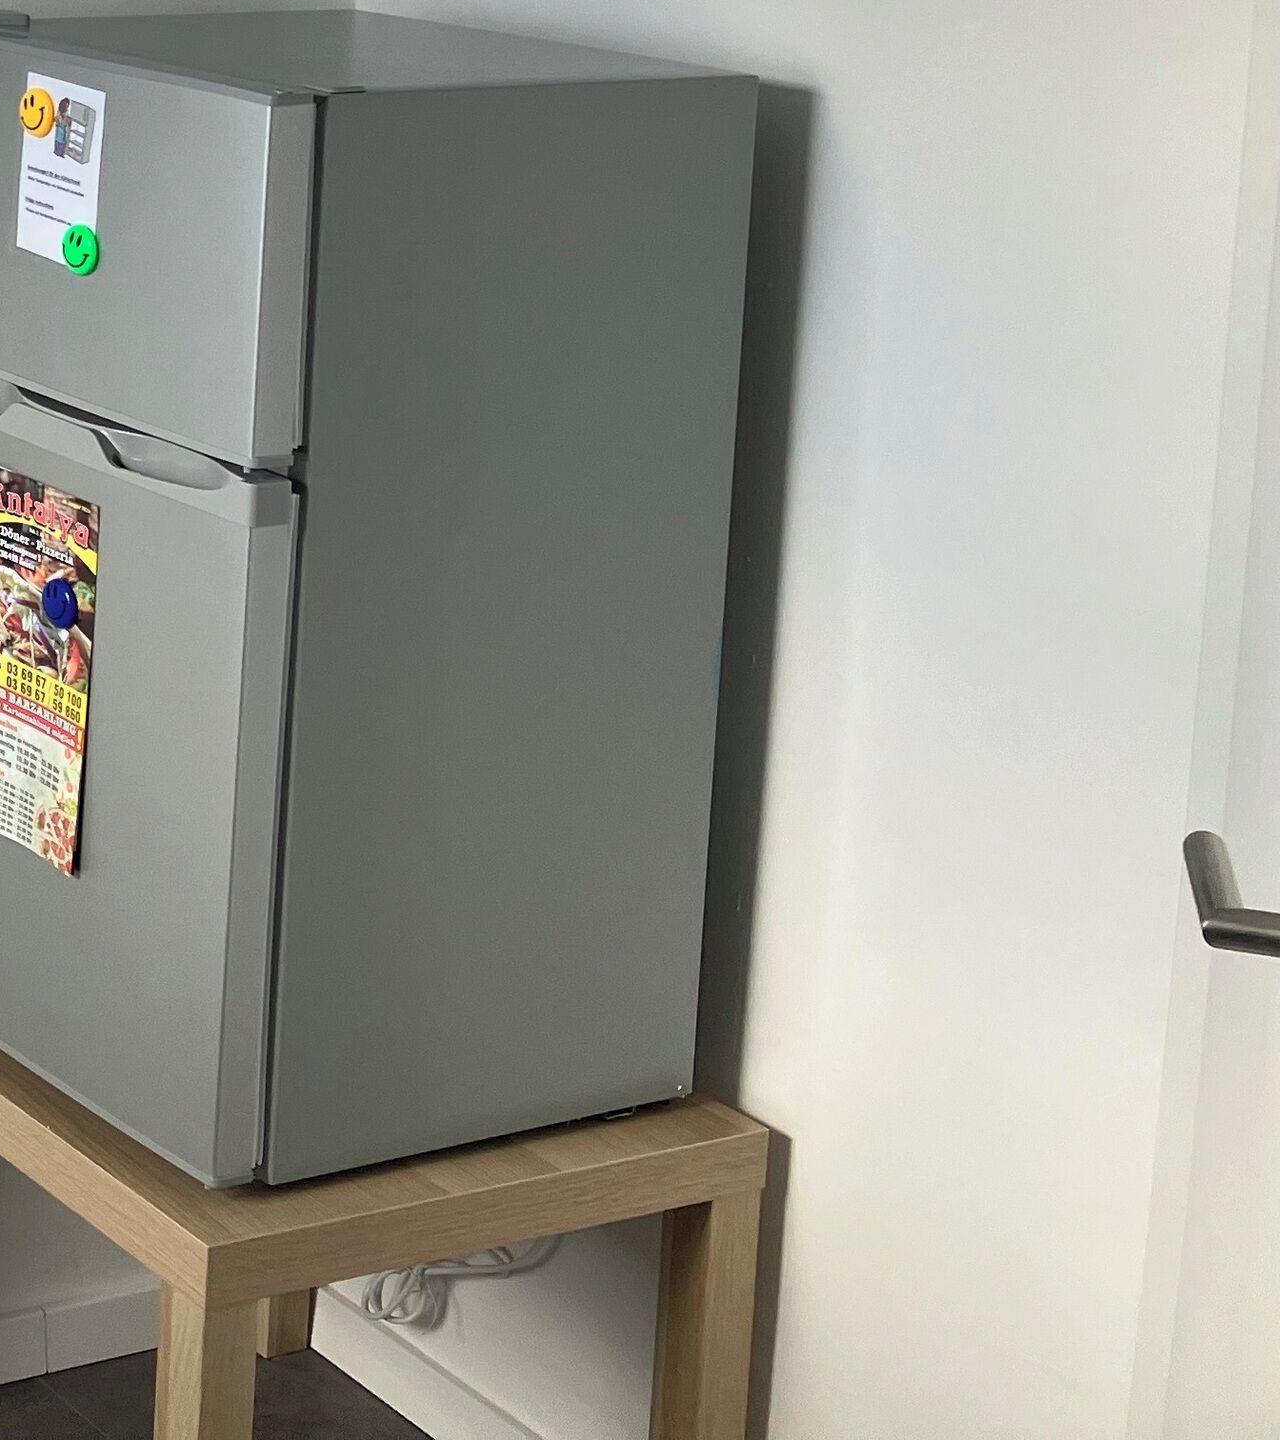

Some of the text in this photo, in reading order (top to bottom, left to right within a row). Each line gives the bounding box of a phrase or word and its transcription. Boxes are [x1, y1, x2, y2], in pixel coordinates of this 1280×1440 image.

[0, 525, 31, 546] Döner
[36, 539, 74, 566] Pizzeria
[6, 676, 18, 690] 03
[21, 682, 32, 696] 69
[35, 689, 46, 703] 67
[53, 698, 63, 713] 59
[65, 706, 81, 723] 860
[7, 662, 18, 676] 03
[21, 669, 32, 682] 69
[36, 675, 46, 689] 67
[54, 684, 64, 699] 50
[67, 691, 82, 709] 100
[9, 692, 77, 735] BARZAHLUNG
